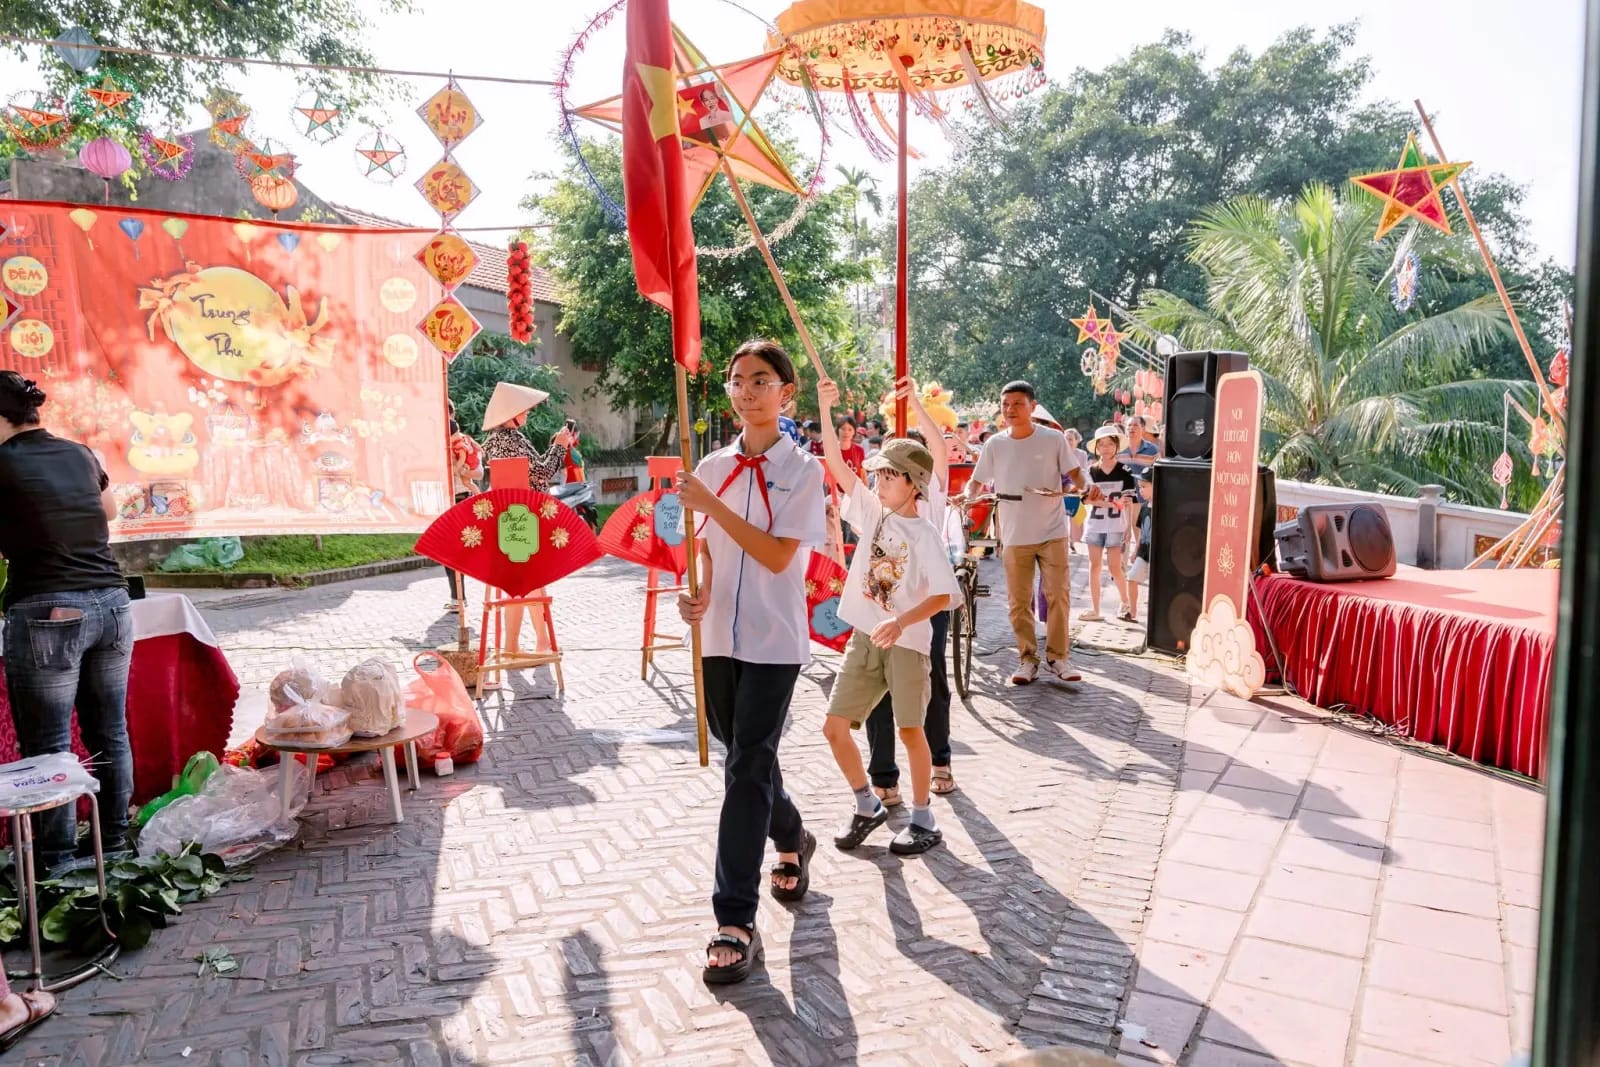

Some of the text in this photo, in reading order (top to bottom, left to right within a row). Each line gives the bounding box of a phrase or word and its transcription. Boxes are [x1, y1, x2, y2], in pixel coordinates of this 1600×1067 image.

[8, 267, 42, 281] ĐÊM
[20, 331, 45, 345] HỘI
[205, 332, 243, 357] Thu
